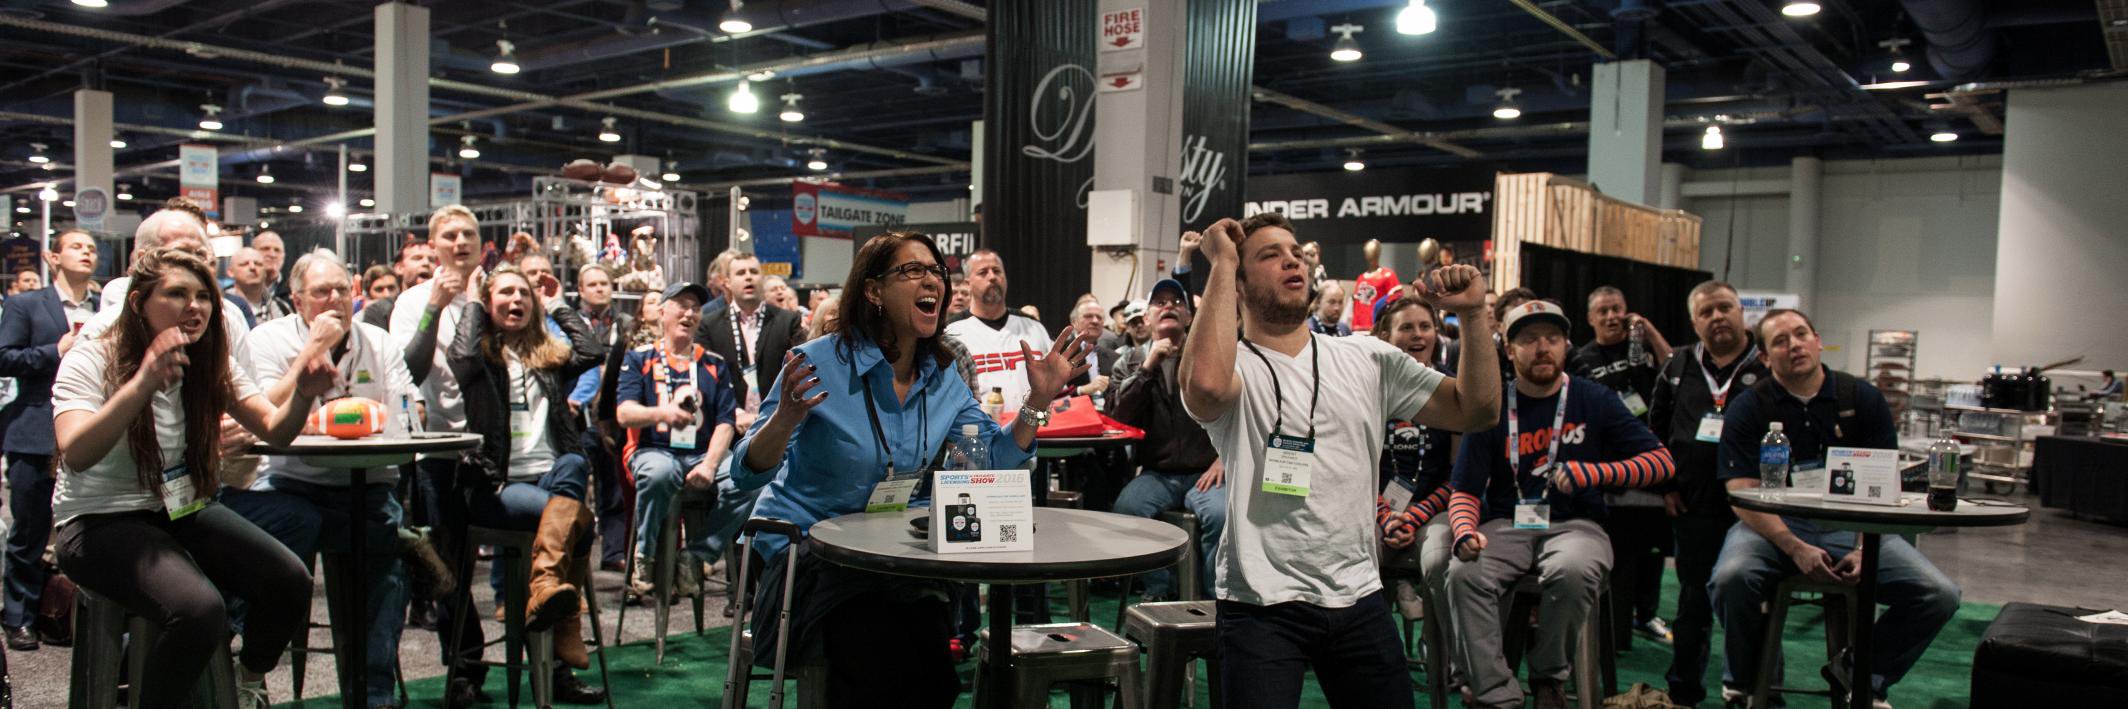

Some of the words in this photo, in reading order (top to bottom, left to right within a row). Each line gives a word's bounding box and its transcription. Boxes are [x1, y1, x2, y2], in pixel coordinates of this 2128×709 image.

[1104, 9, 1140, 25] FIRE
[1104, 21, 1141, 37] HOSE
[820, 205, 872, 224] TAILGATE
[875, 211, 907, 227] ZONE
[1243, 199, 1329, 219] NDER
[971, 350, 1043, 374] ESP
